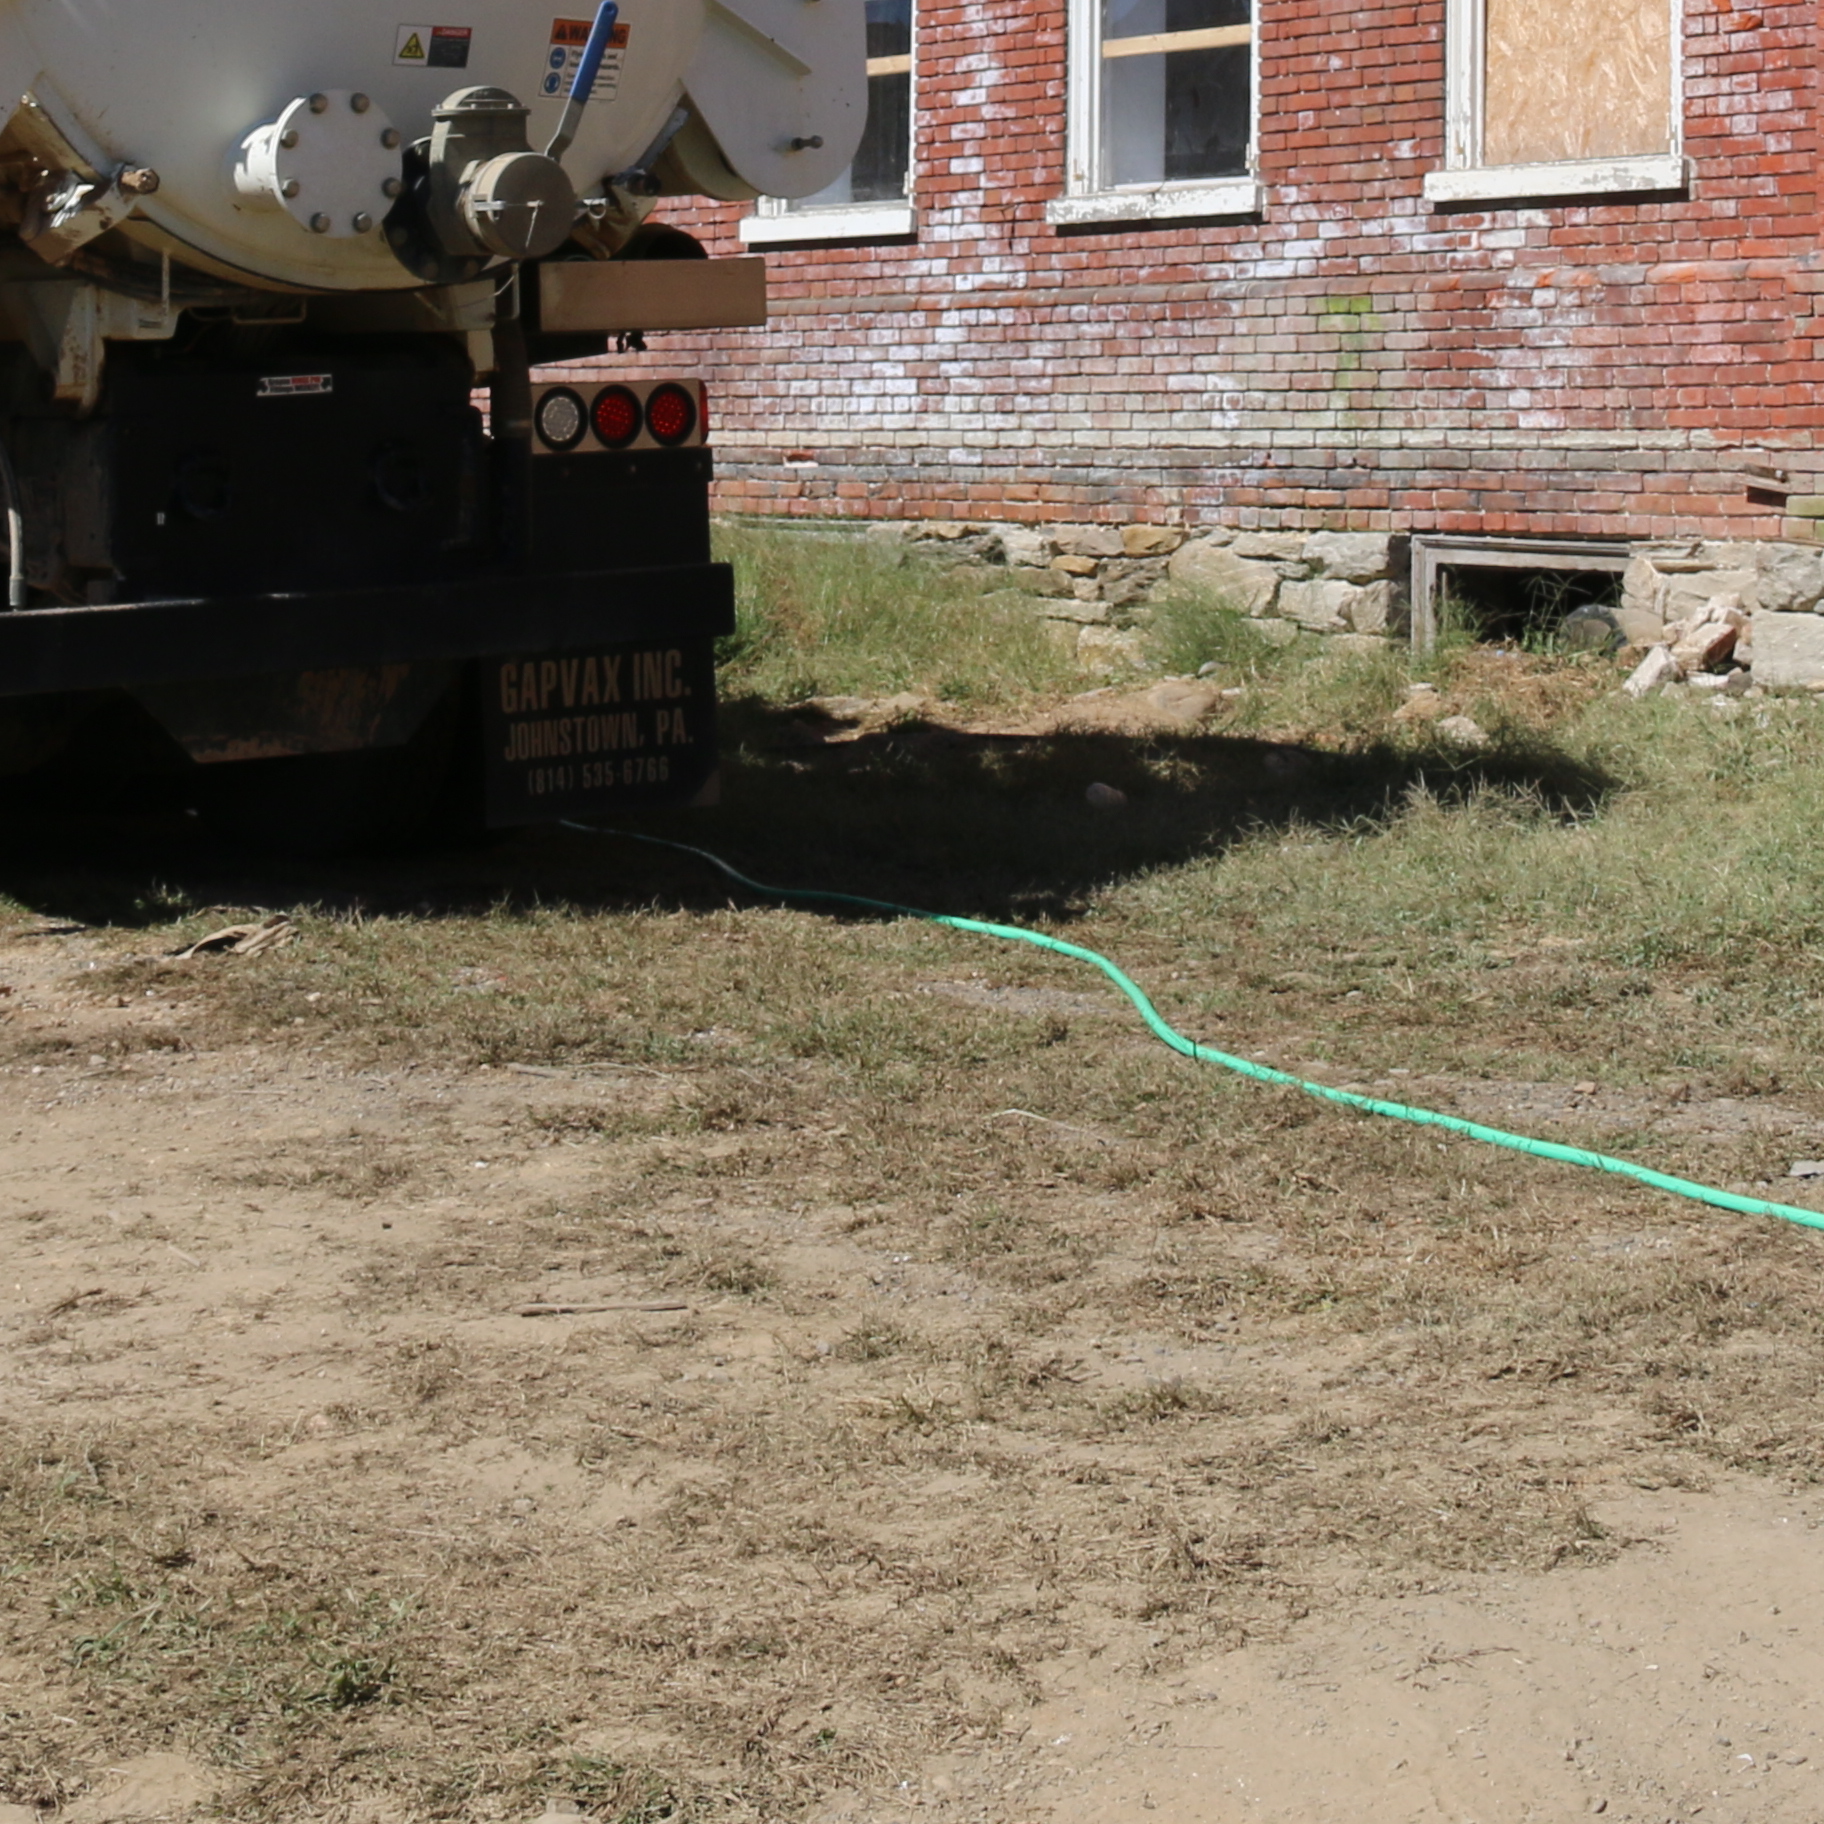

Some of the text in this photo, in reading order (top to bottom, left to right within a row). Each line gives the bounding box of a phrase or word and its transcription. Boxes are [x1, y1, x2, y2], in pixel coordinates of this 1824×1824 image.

[499, 648, 693, 715] GAPVAX INC.
[655, 706, 694, 746] PA.
[527, 755, 670, 796] (814) 535-6766
